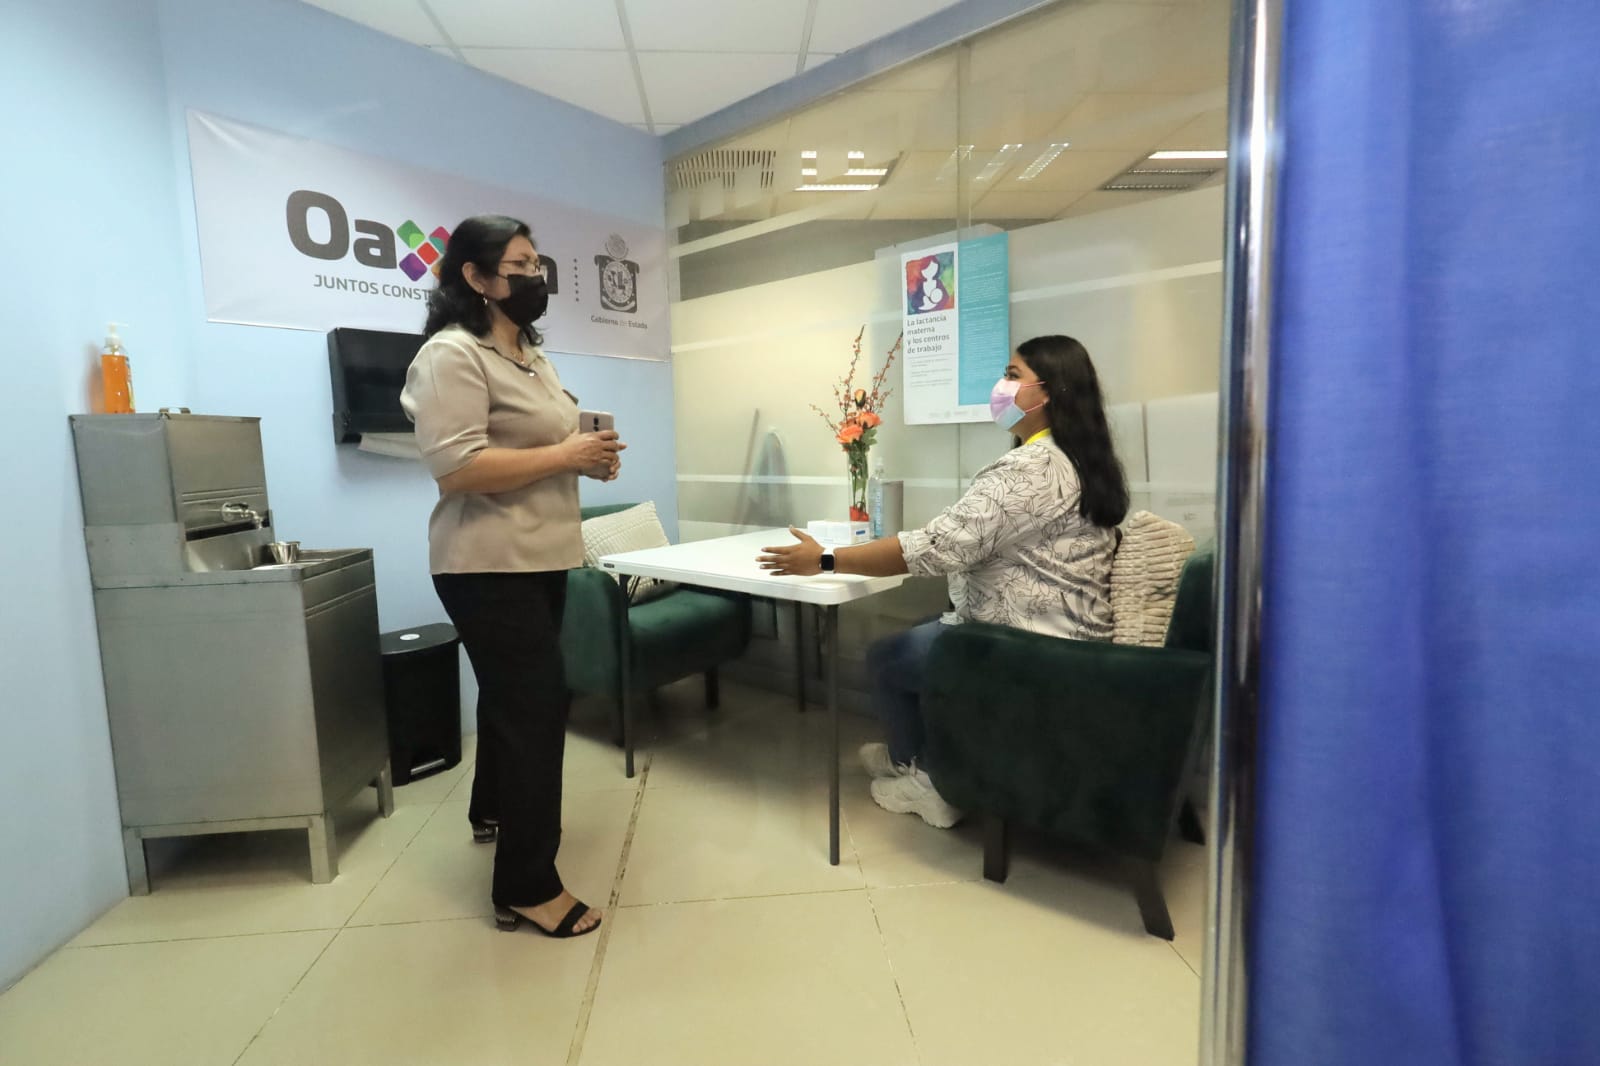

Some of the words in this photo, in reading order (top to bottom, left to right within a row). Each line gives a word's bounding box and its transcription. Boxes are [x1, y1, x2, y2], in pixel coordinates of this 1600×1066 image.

[313, 274, 379, 295] JUNTOS
[382, 284, 432, 301] CONST
[907, 327, 935, 335] materna
[912, 336, 923, 344] los
[923, 334, 950, 343] centros
[916, 344, 942, 353] trabajo
